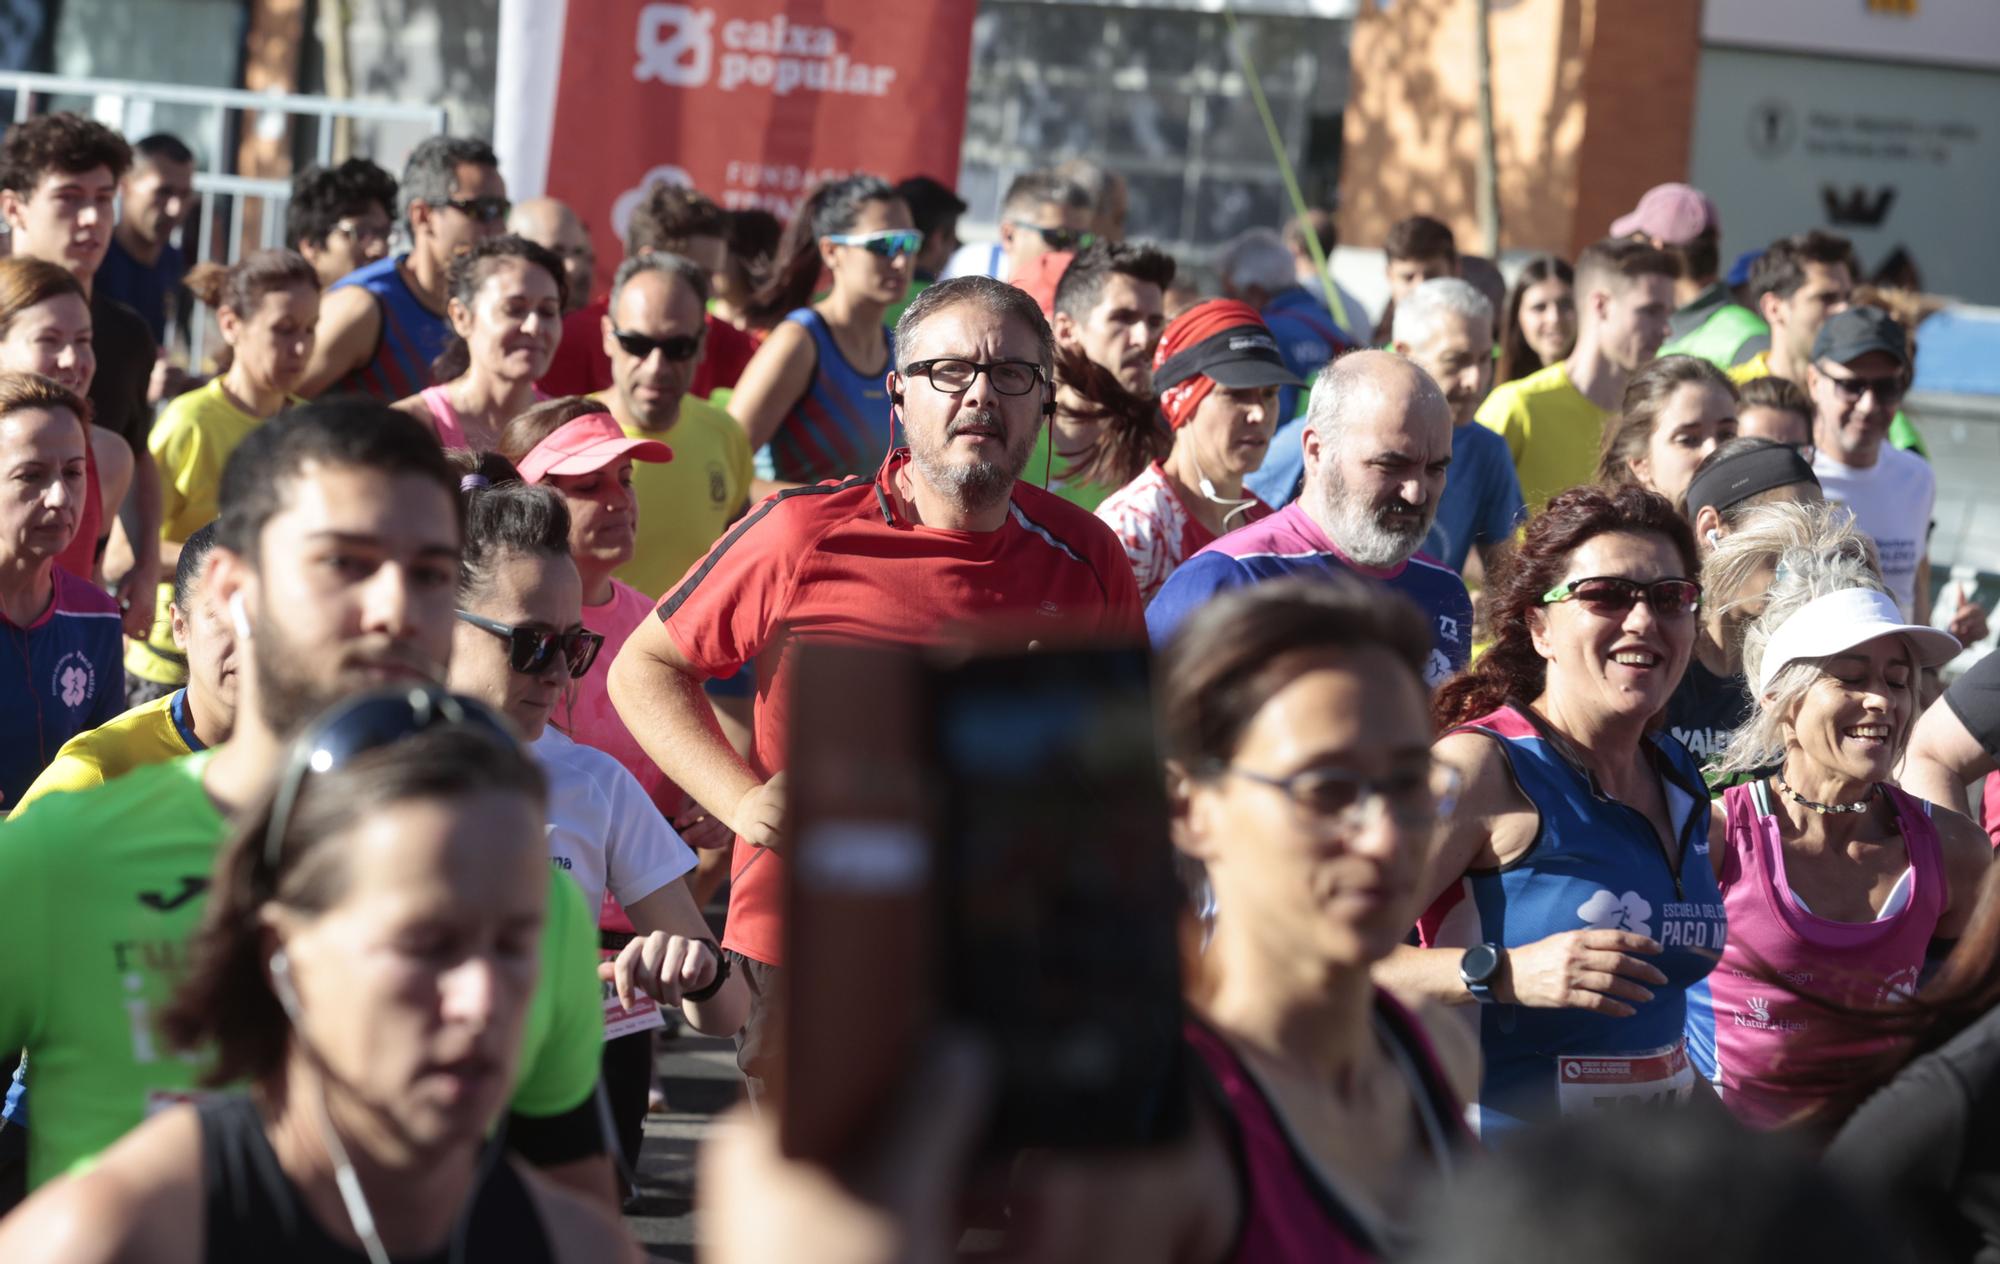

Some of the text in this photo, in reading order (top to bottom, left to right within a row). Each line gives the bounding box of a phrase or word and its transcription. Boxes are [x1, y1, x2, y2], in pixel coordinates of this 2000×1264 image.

[721, 14, 836, 55] caixa
[719, 53, 896, 96] popular
[1663, 903, 1702, 918] ESCUELA
[1702, 903, 1717, 919] DEL
[1660, 921, 1708, 948] PACO
